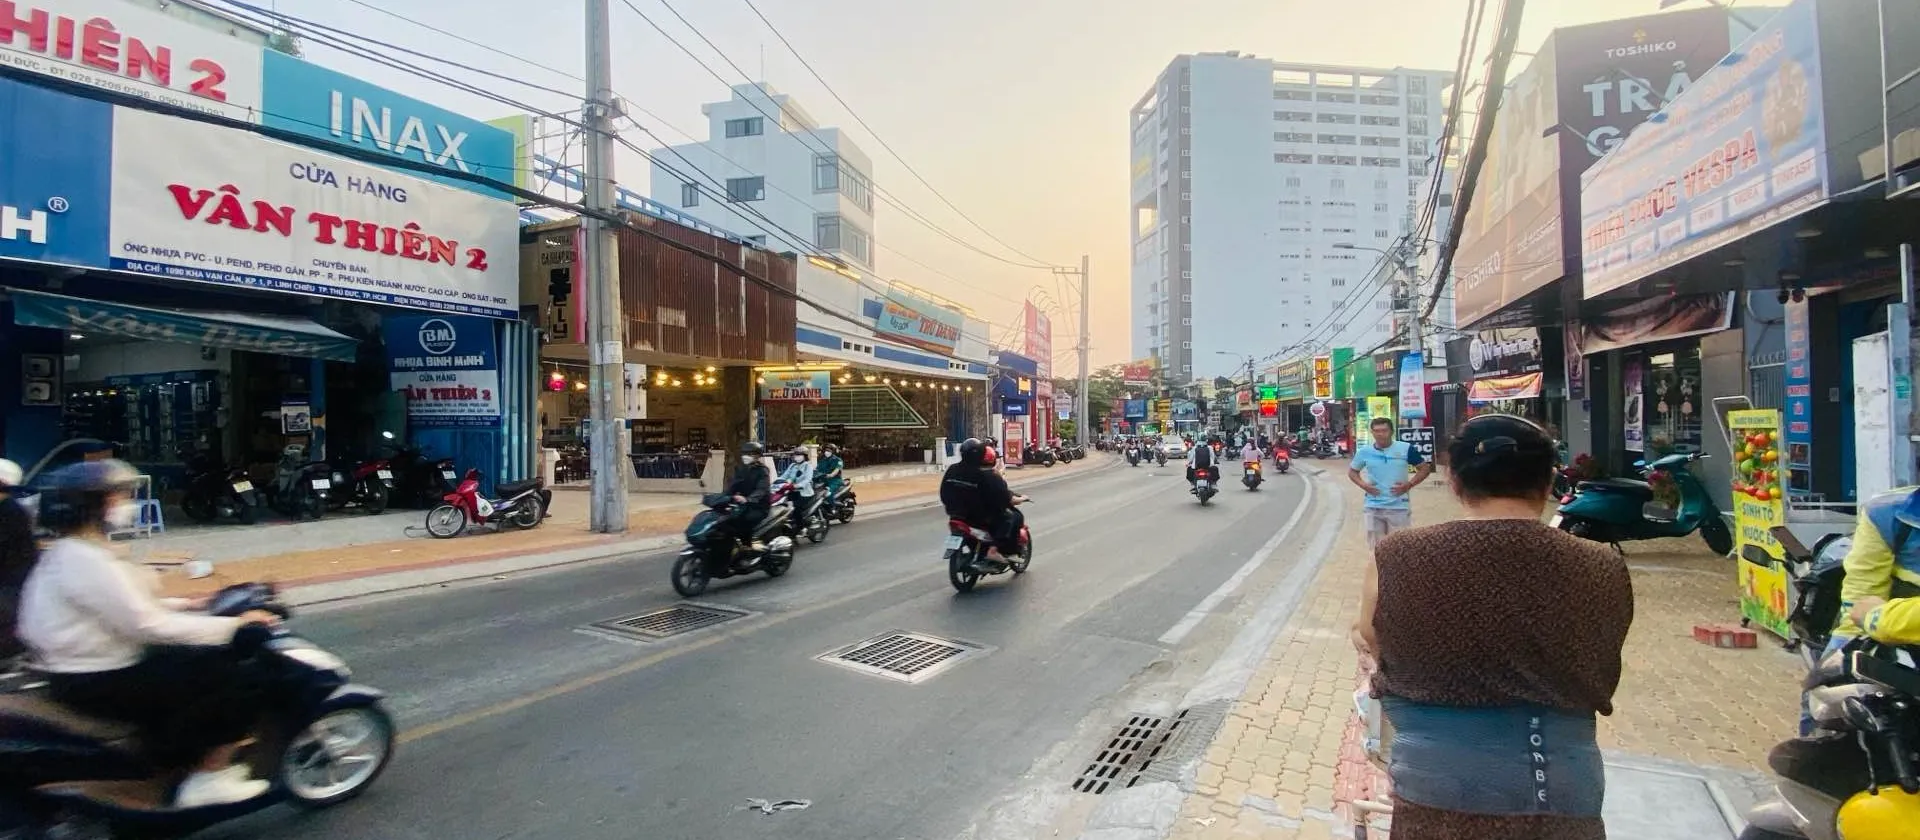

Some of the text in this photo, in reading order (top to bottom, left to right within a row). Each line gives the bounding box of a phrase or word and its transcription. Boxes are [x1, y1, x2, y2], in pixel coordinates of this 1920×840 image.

[1604, 40, 1676, 58] TOSHIKO
[190, 59, 226, 102] 2
[329, 90, 469, 173] INAX
[289, 160, 407, 203] CỬA HÀNG
[1683, 127, 1759, 198] VESPA
[167, 183, 488, 272] VÂN THIÊN 2
[127, 261, 143, 272] ĐỊA
[184, 251, 206, 262] PVC
[1463, 251, 1501, 293] TOSHIKO
[481, 389, 491, 401] 2
[792, 388, 822, 399] DANH
